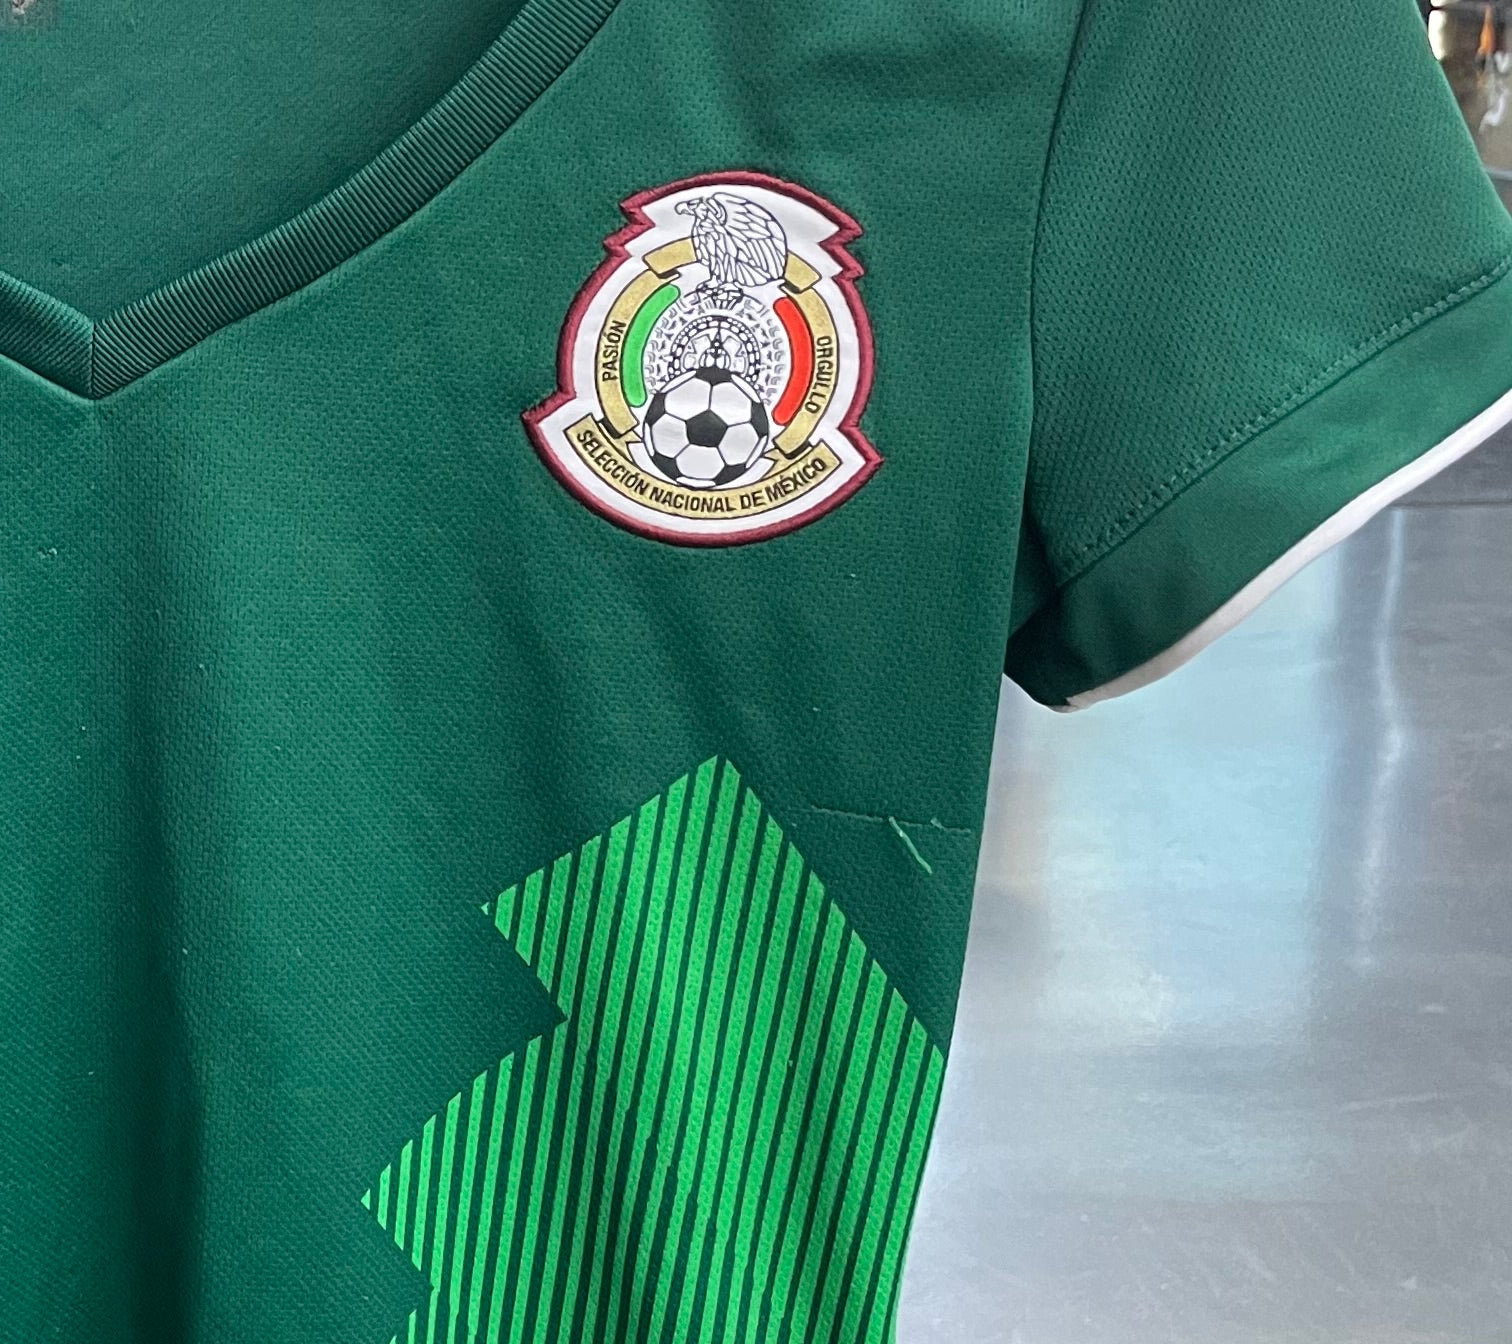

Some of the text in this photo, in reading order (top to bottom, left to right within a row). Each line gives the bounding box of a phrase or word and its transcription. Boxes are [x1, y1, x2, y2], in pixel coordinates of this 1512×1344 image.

[602, 319, 629, 382] PASIÓN
[807, 335, 834, 415] ORGULLO
[576, 429, 828, 514] SELECCIÓN NACIONAL DE MÉXICO
